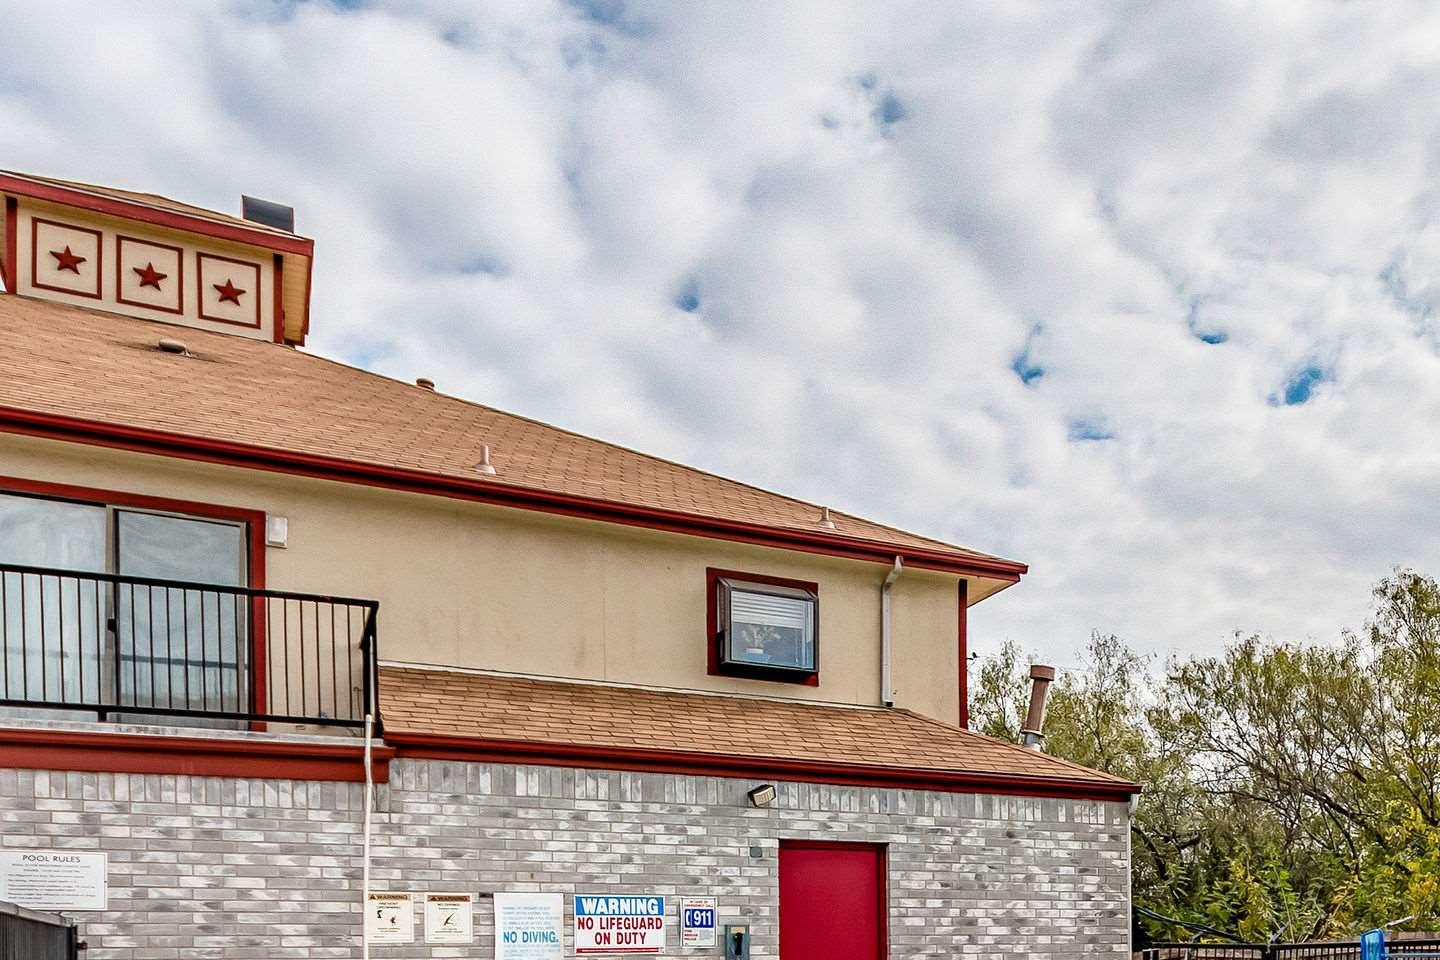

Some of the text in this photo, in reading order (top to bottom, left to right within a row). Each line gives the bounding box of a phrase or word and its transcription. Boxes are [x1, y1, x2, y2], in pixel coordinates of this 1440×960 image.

[22, 854, 81, 863] POOL RULES
[581, 897, 659, 915] WARNING
[577, 917, 663, 930] NO LIFEGUARD
[693, 910, 712, 926] 911
[503, 931, 559, 943] NO DIVING.
[594, 932, 647, 945] ON DUTY
